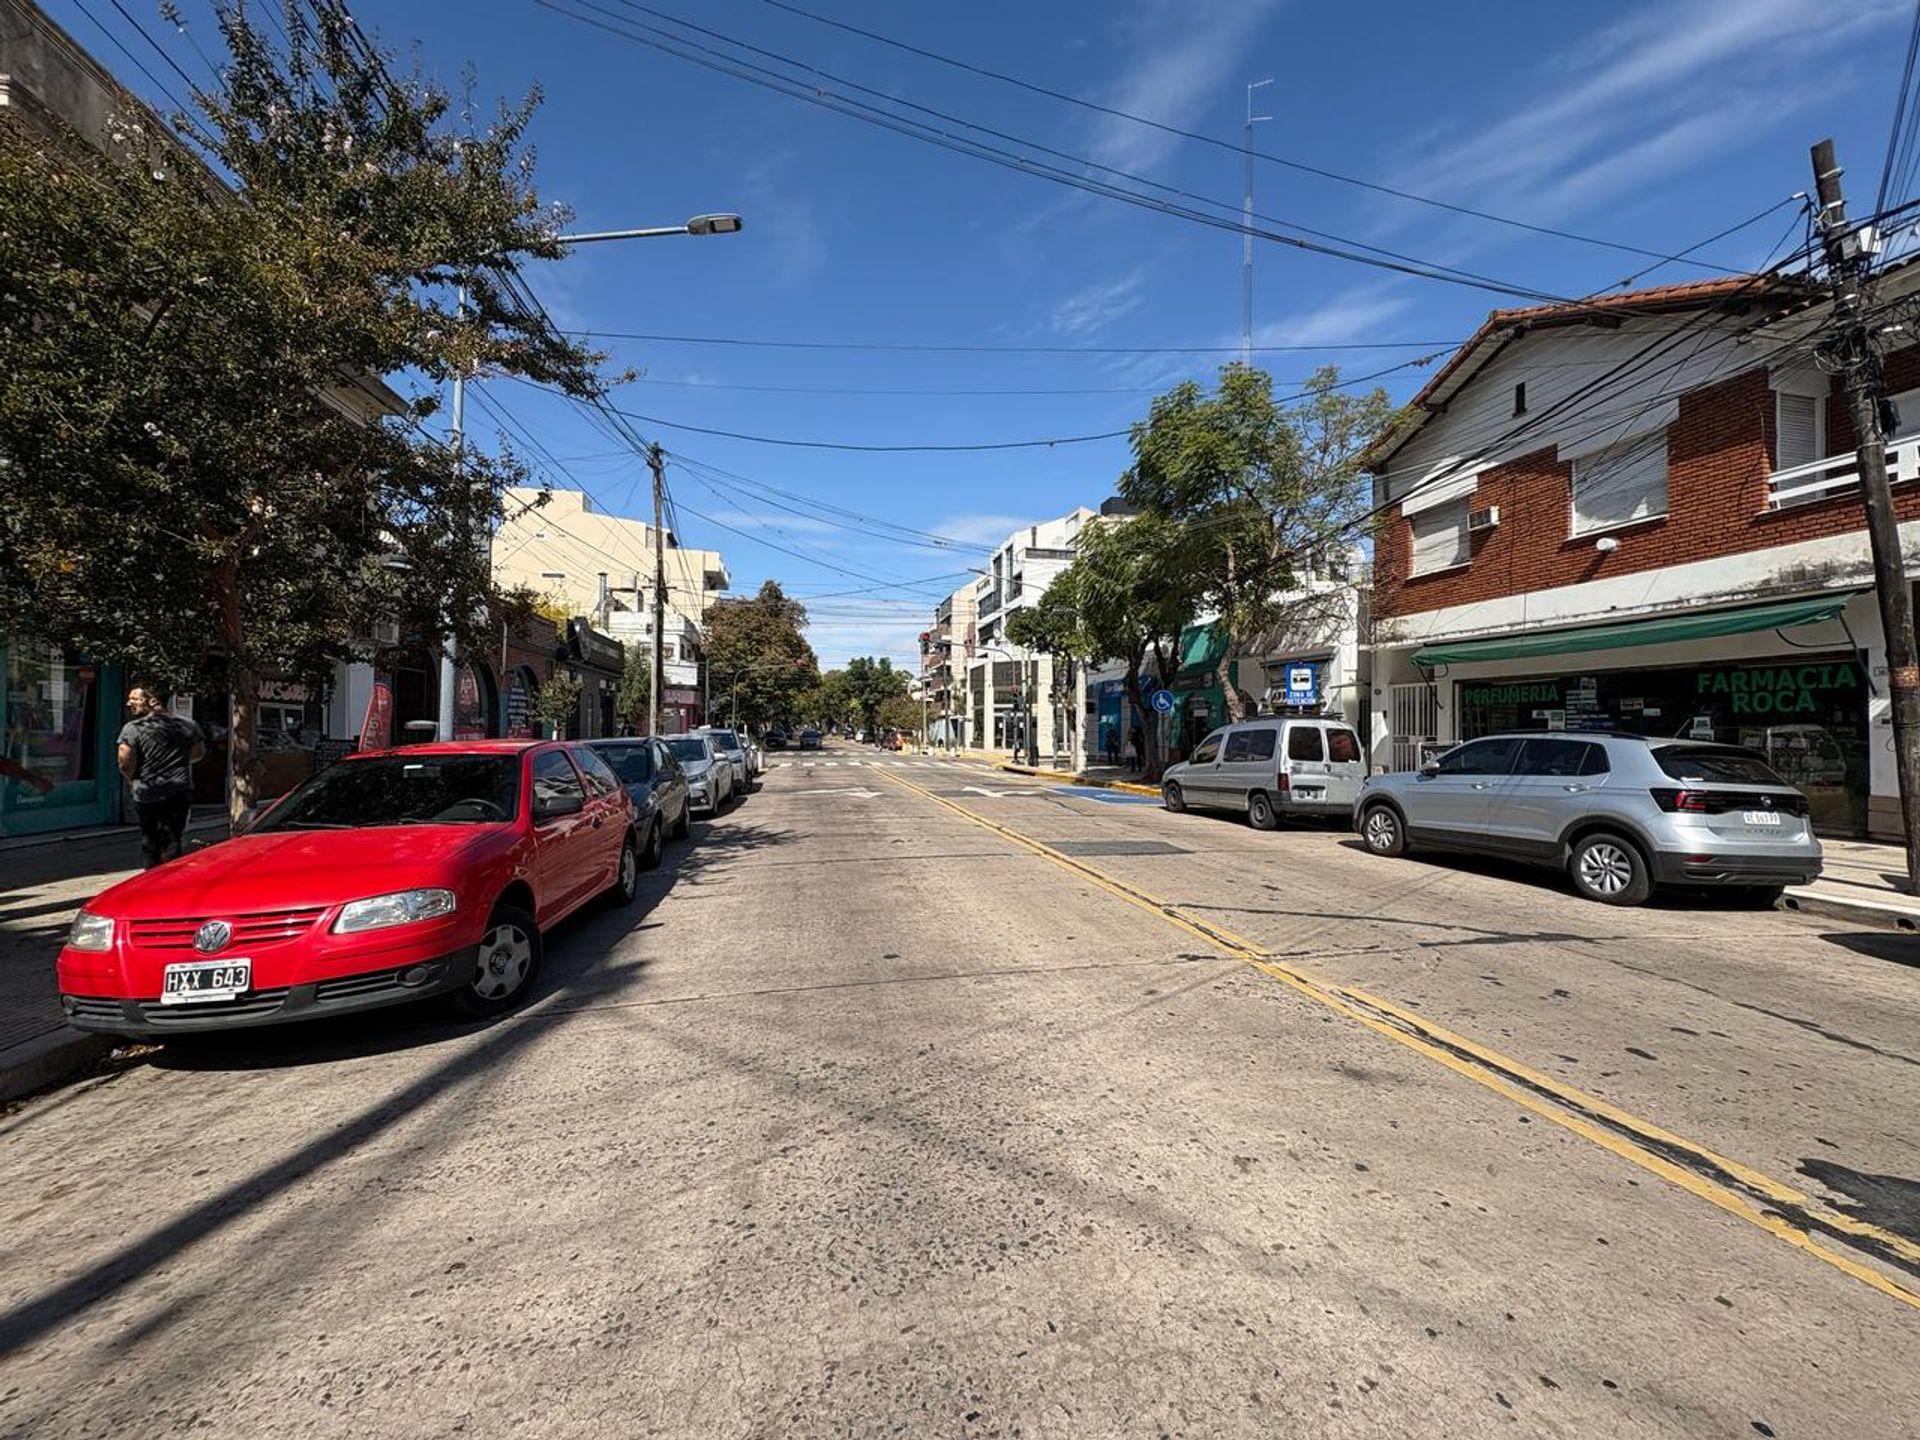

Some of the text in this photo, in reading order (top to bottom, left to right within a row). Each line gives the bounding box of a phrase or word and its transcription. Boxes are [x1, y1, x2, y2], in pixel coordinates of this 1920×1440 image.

[1697, 664, 1857, 693] FARMACIA
[1464, 684, 1559, 704] PERFUMERIA
[1732, 690, 1816, 713] ROCA
[167, 967, 246, 991] HXX 643
